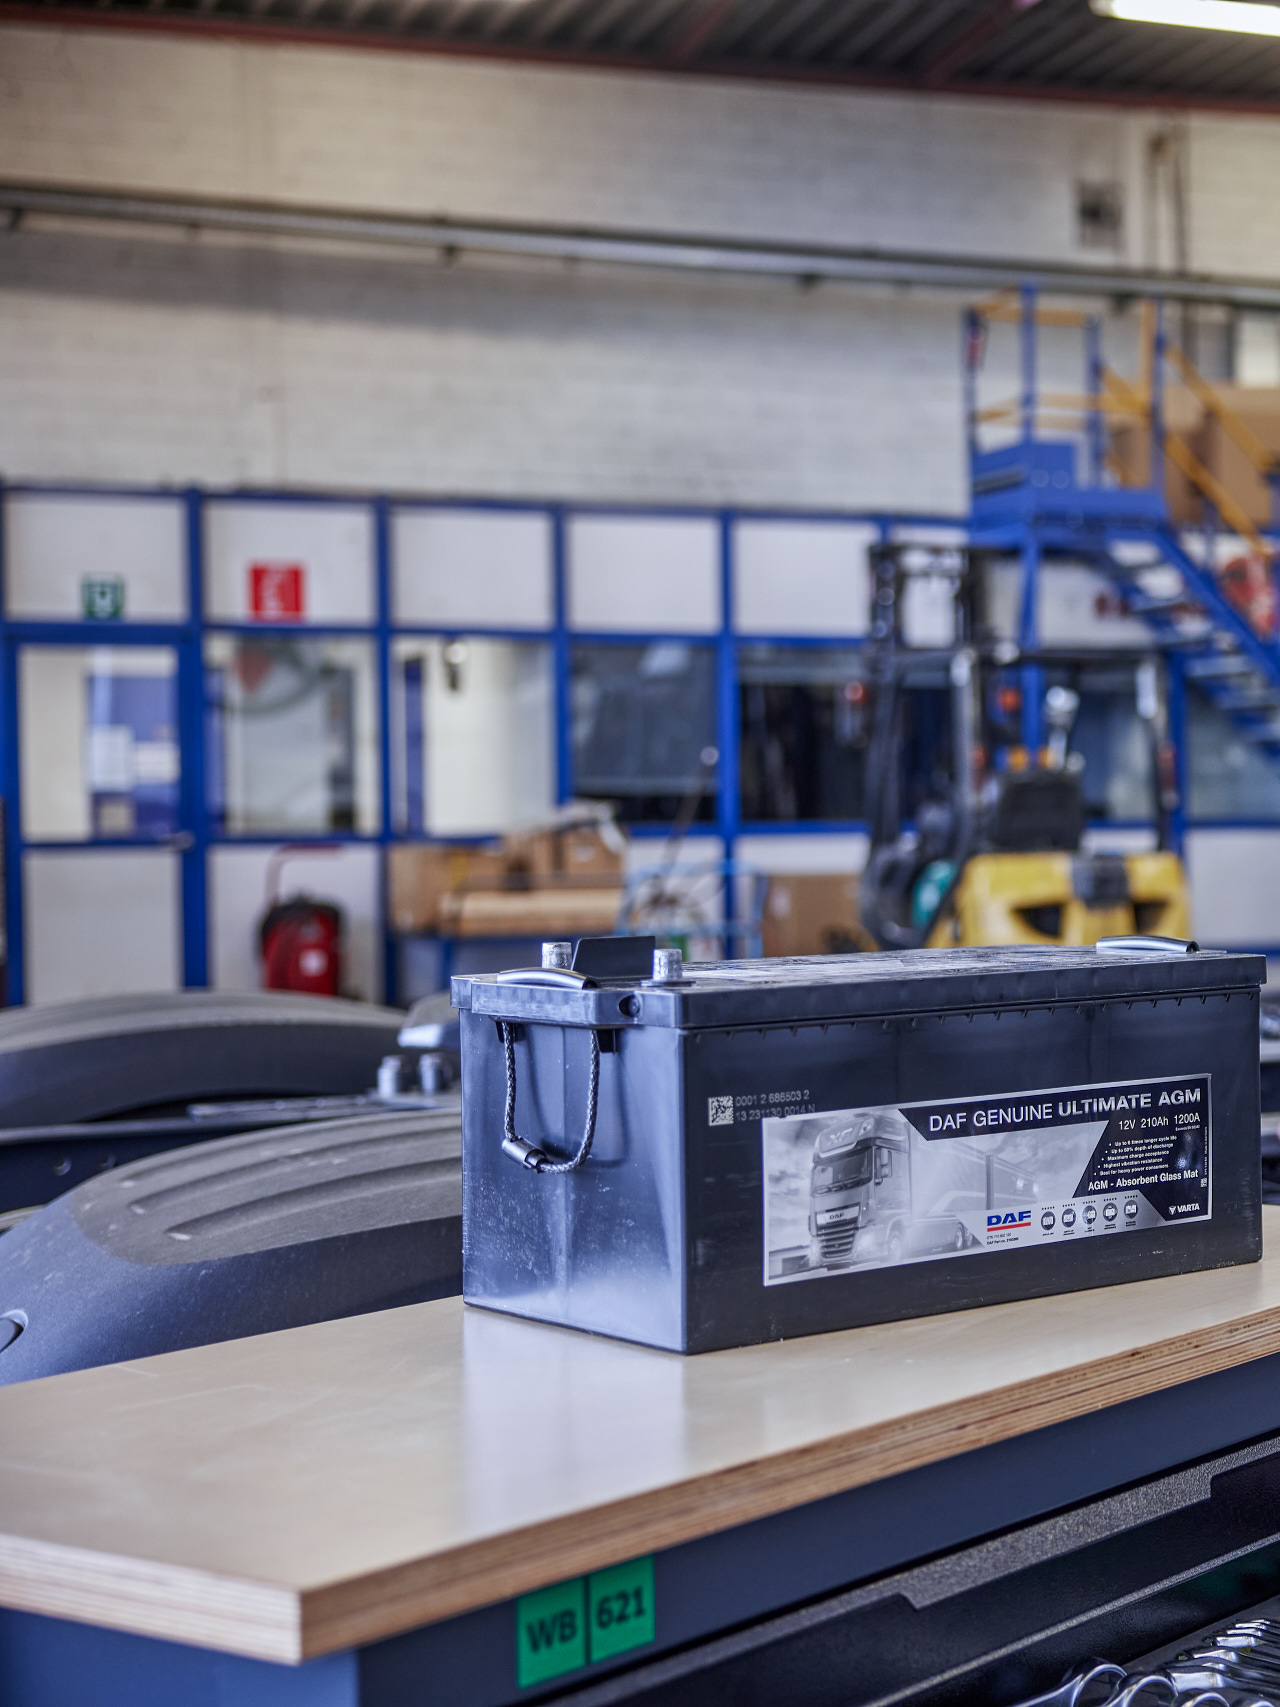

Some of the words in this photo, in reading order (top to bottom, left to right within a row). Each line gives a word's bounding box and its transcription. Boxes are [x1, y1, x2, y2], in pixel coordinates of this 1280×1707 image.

[735, 1095, 758, 1107] 0001
[760, 1093, 767, 1105] 2
[803, 1089, 810, 1100] 2
[736, 1110, 748, 1122] 13
[808, 1103, 816, 1114] N
[929, 1113, 967, 1133] DAF
[973, 1103, 1053, 1127] GENUINE
[1058, 1092, 1152, 1117] ULTIMATE
[1158, 1088, 1201, 1107] AGM
[1119, 1119, 1136, 1131] 12V
[1140, 1116, 1169, 1129] 210Ah
[1174, 1112, 1201, 1125] 1200A
[1103, 1161, 1120, 1169] Highest
[1129, 1152, 1144, 1160] charge
[1088, 1179, 1108, 1191] AGM
[1116, 1175, 1158, 1188] Absorbent
[1159, 1172, 1182, 1183] Glass
[1183, 1169, 1199, 1179] Mat
[1176, 1203, 1200, 1213] VARTA
[987, 1210, 1031, 1227] DAF
[525, 1608, 577, 1654] WB
[596, 1585, 646, 1630] 621
